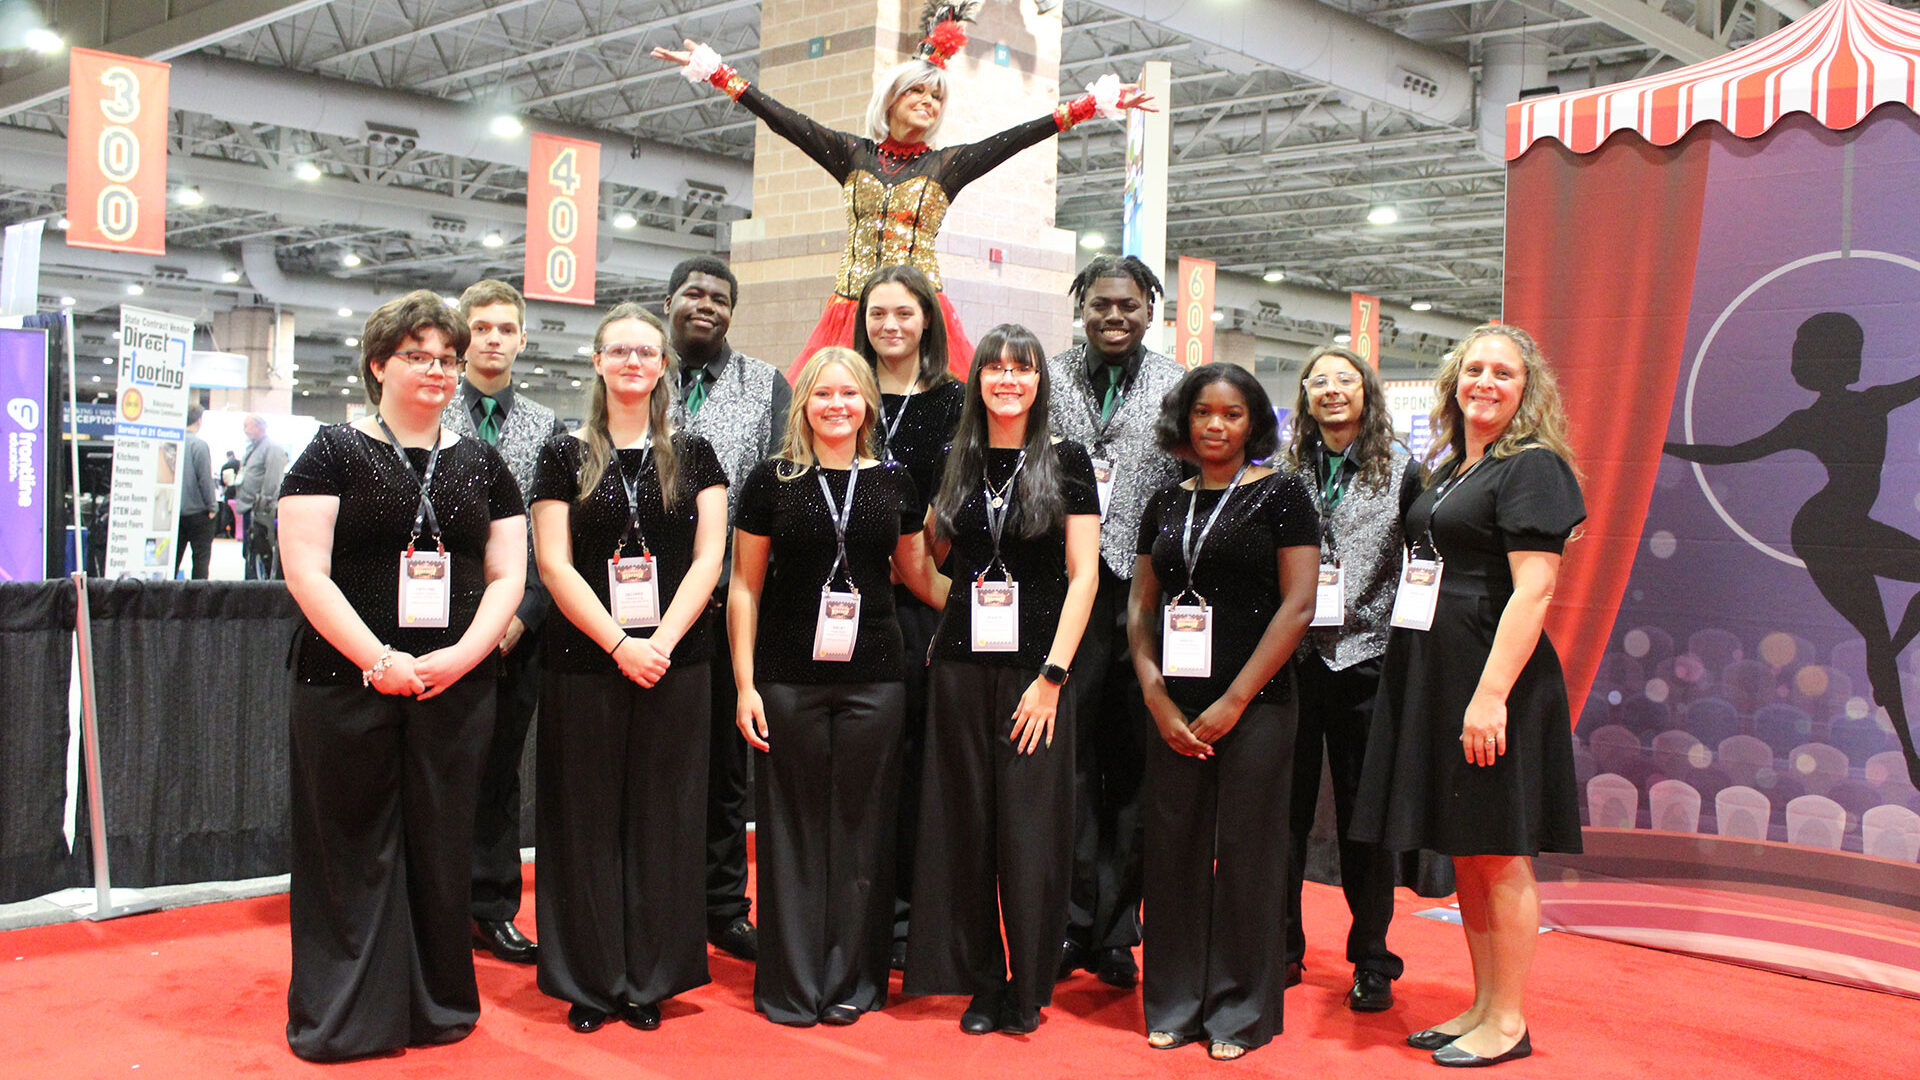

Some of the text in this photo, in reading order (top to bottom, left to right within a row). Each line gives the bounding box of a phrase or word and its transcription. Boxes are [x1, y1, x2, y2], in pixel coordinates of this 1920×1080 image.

[97, 66, 140, 242] 300
[546, 147, 580, 294] 400
[124, 326, 169, 353] Direct
[1186, 266, 1205, 370] 600
[122, 351, 184, 389] Flooring
[18, 432, 37, 507] frontline
